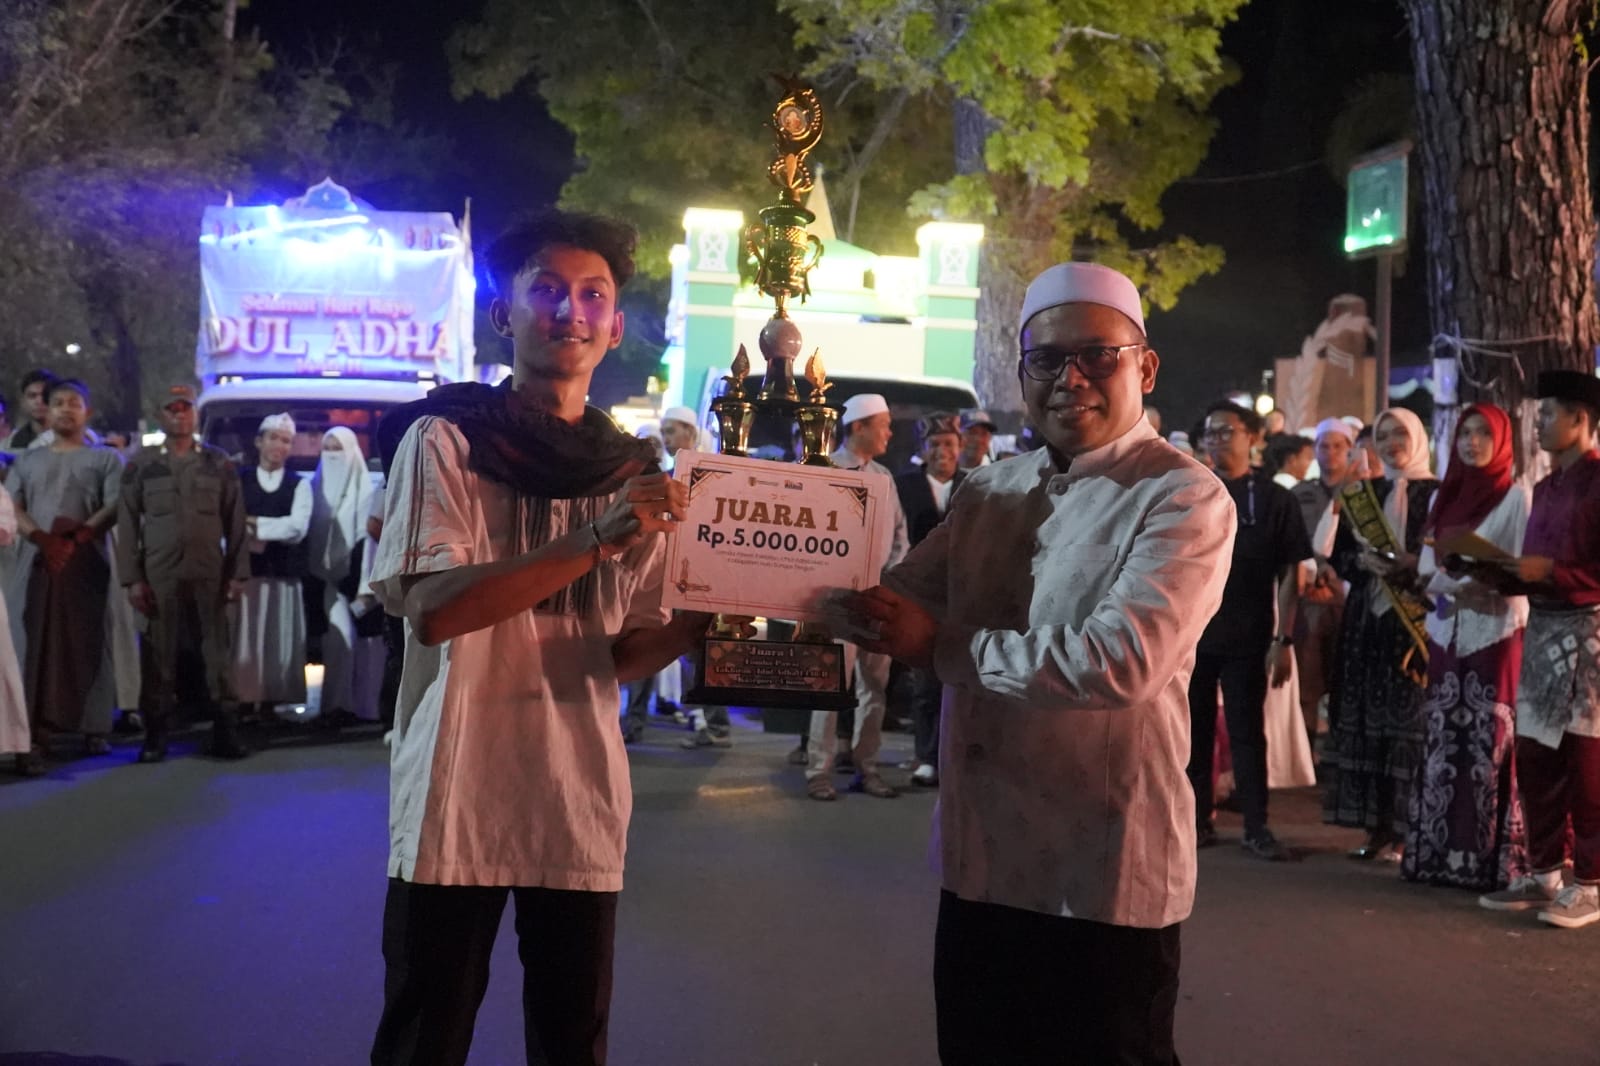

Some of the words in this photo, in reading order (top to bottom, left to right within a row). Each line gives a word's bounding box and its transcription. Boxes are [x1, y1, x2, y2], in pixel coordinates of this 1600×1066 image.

[326, 319, 453, 361] ADHA
[712, 497, 817, 529] JUARA
[826, 509, 839, 532] 1
[697, 524, 850, 557] Rp.5.000.000
